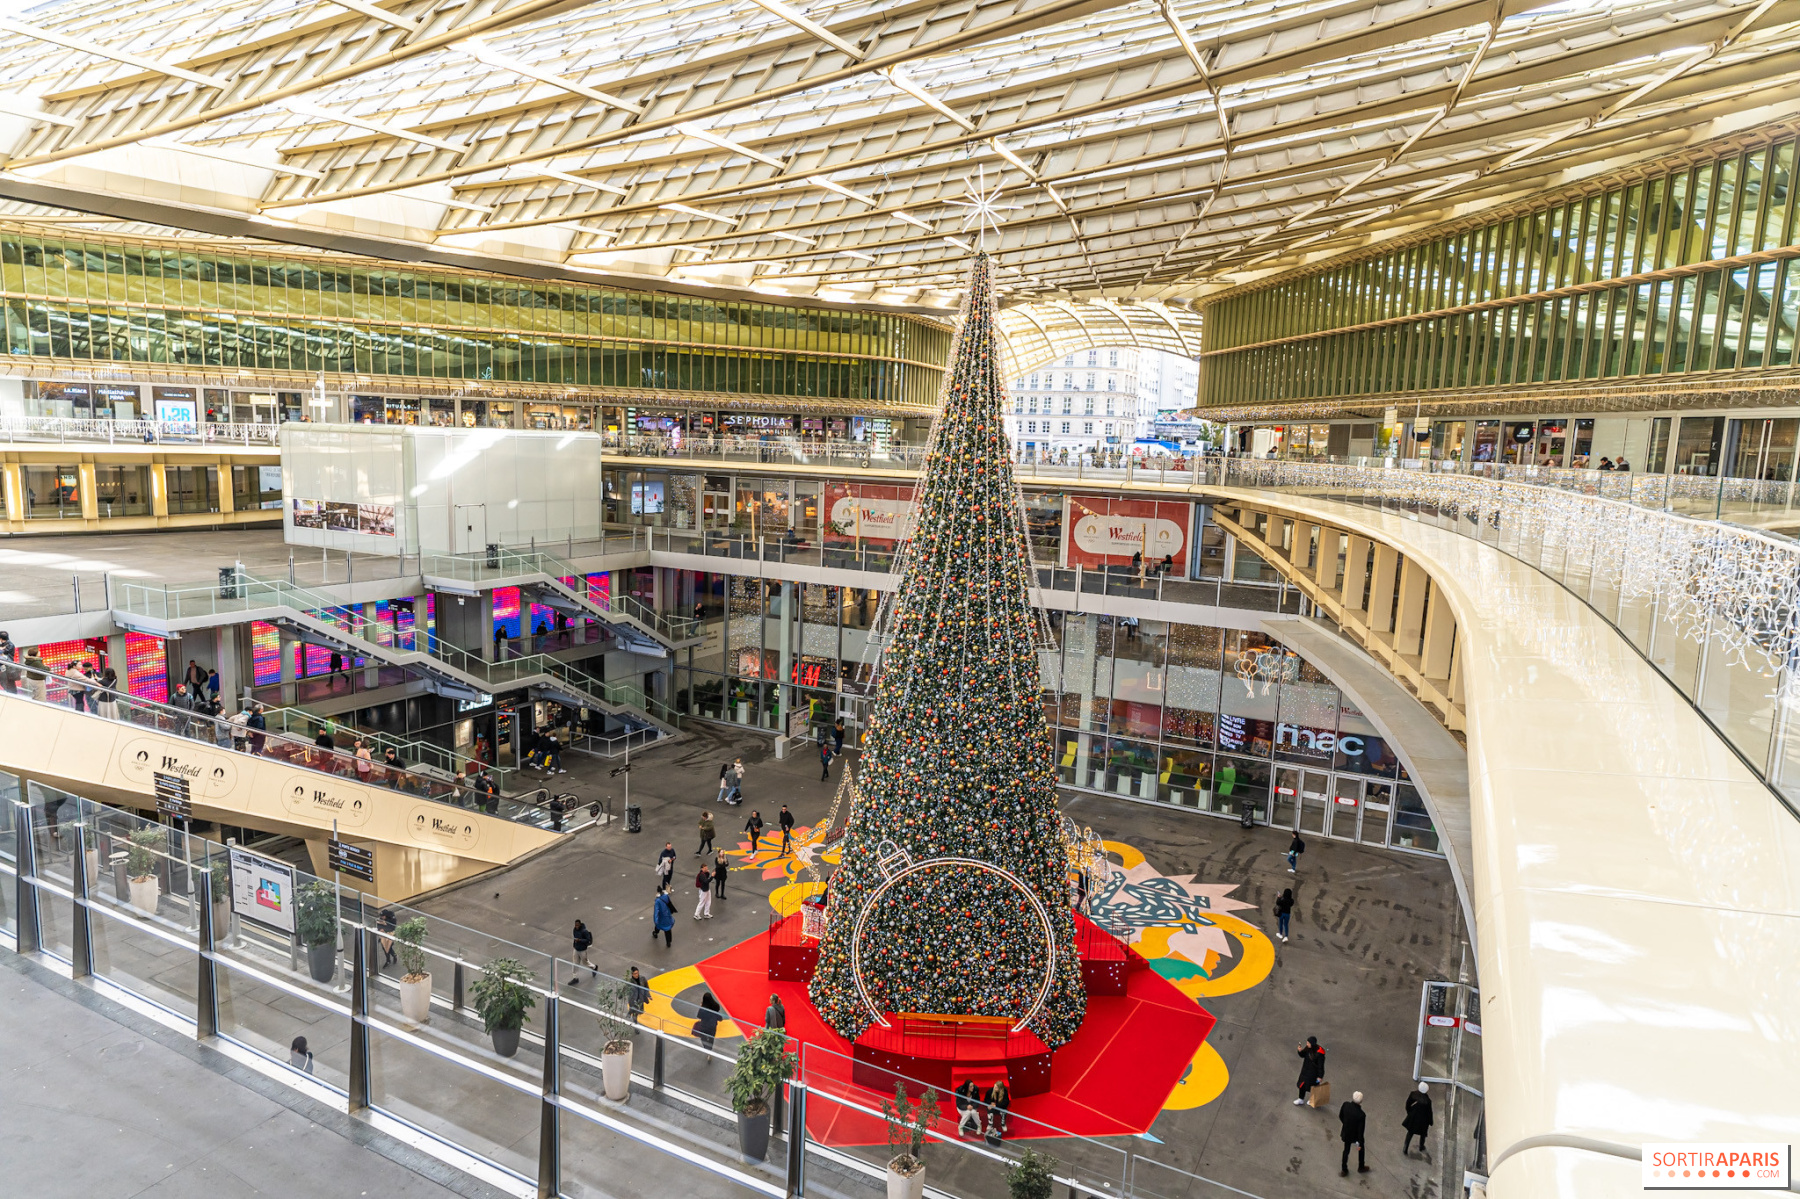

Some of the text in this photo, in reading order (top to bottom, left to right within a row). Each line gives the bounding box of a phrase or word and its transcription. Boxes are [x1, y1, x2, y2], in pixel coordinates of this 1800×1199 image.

[729, 416, 786, 427] SEPHORA
[862, 509, 895, 524] Westfield
[1276, 722, 1364, 756] fnac
[161, 756, 202, 777] Westfield
[313, 790, 346, 809] Westfield
[432, 818, 458, 834] Westfield
